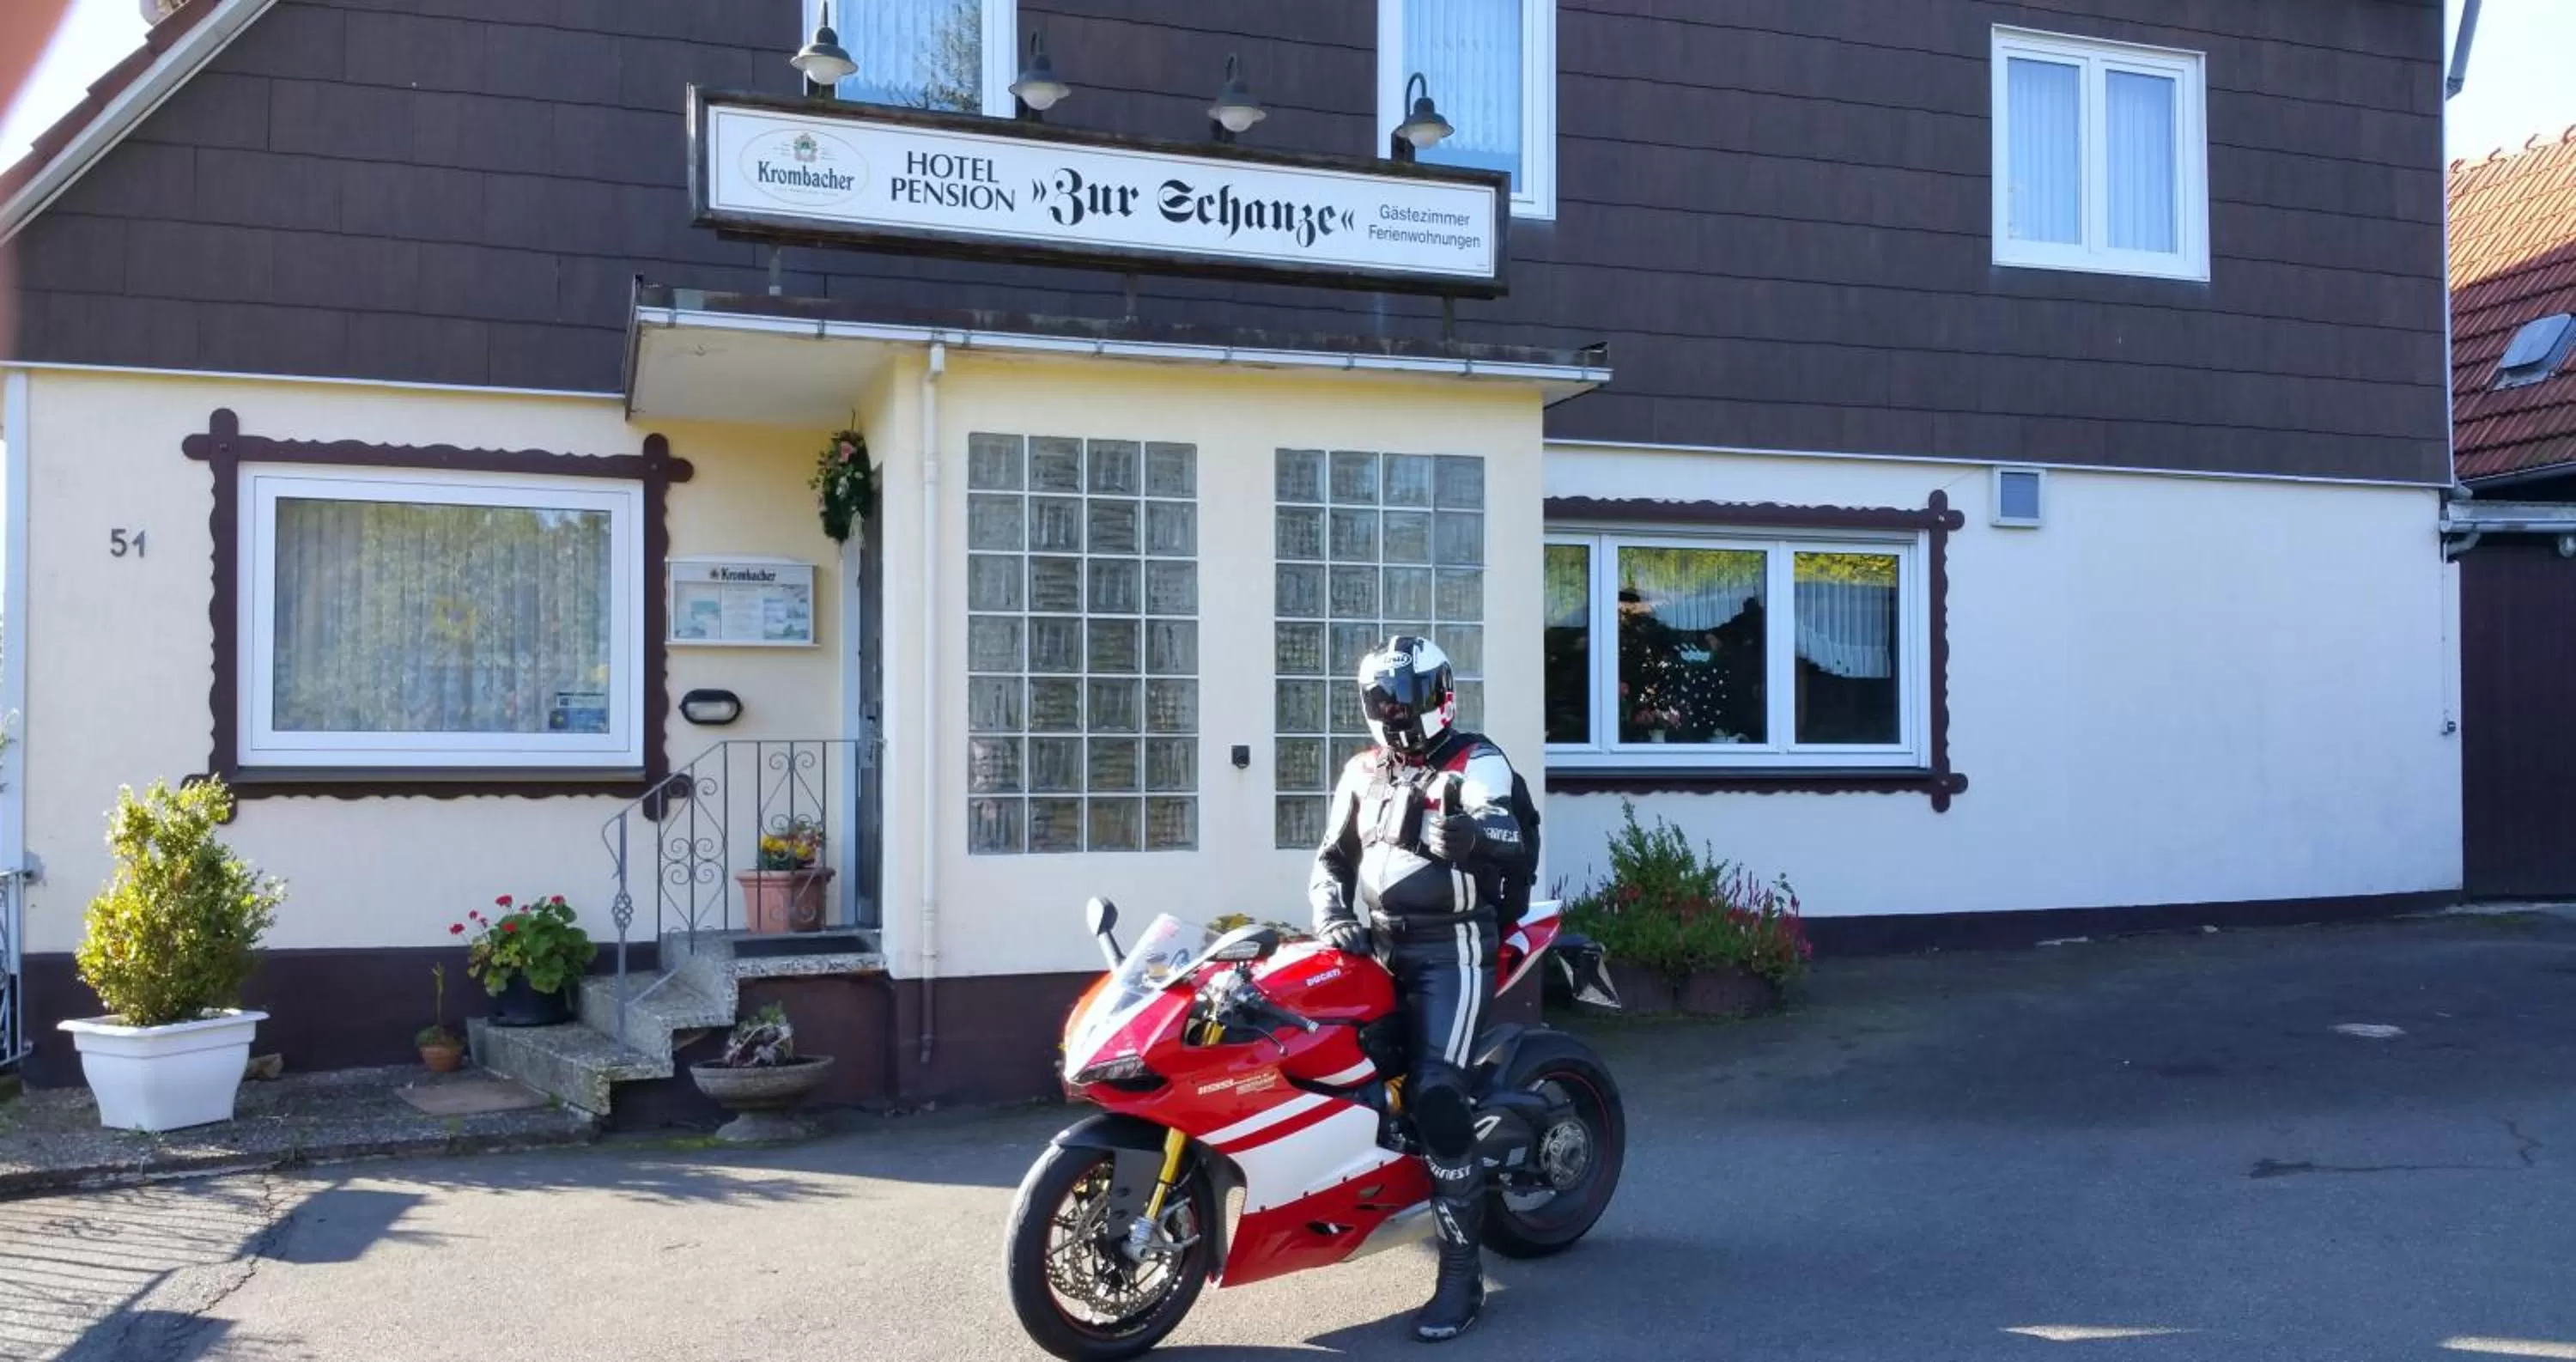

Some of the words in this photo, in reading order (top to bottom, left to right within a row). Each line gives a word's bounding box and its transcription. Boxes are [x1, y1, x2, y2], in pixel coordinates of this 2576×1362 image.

[757, 161, 855, 191] Krombacher
[907, 150, 999, 183] HOTEL
[891, 177, 1015, 212] PENSION
[1380, 204, 1470, 226] Gästezimmer
[1368, 224, 1481, 249] Ferienwohnungen
[110, 528, 145, 558] 51
[721, 567, 776, 581] Krombacher
[1306, 968, 1341, 987] DUCATI
